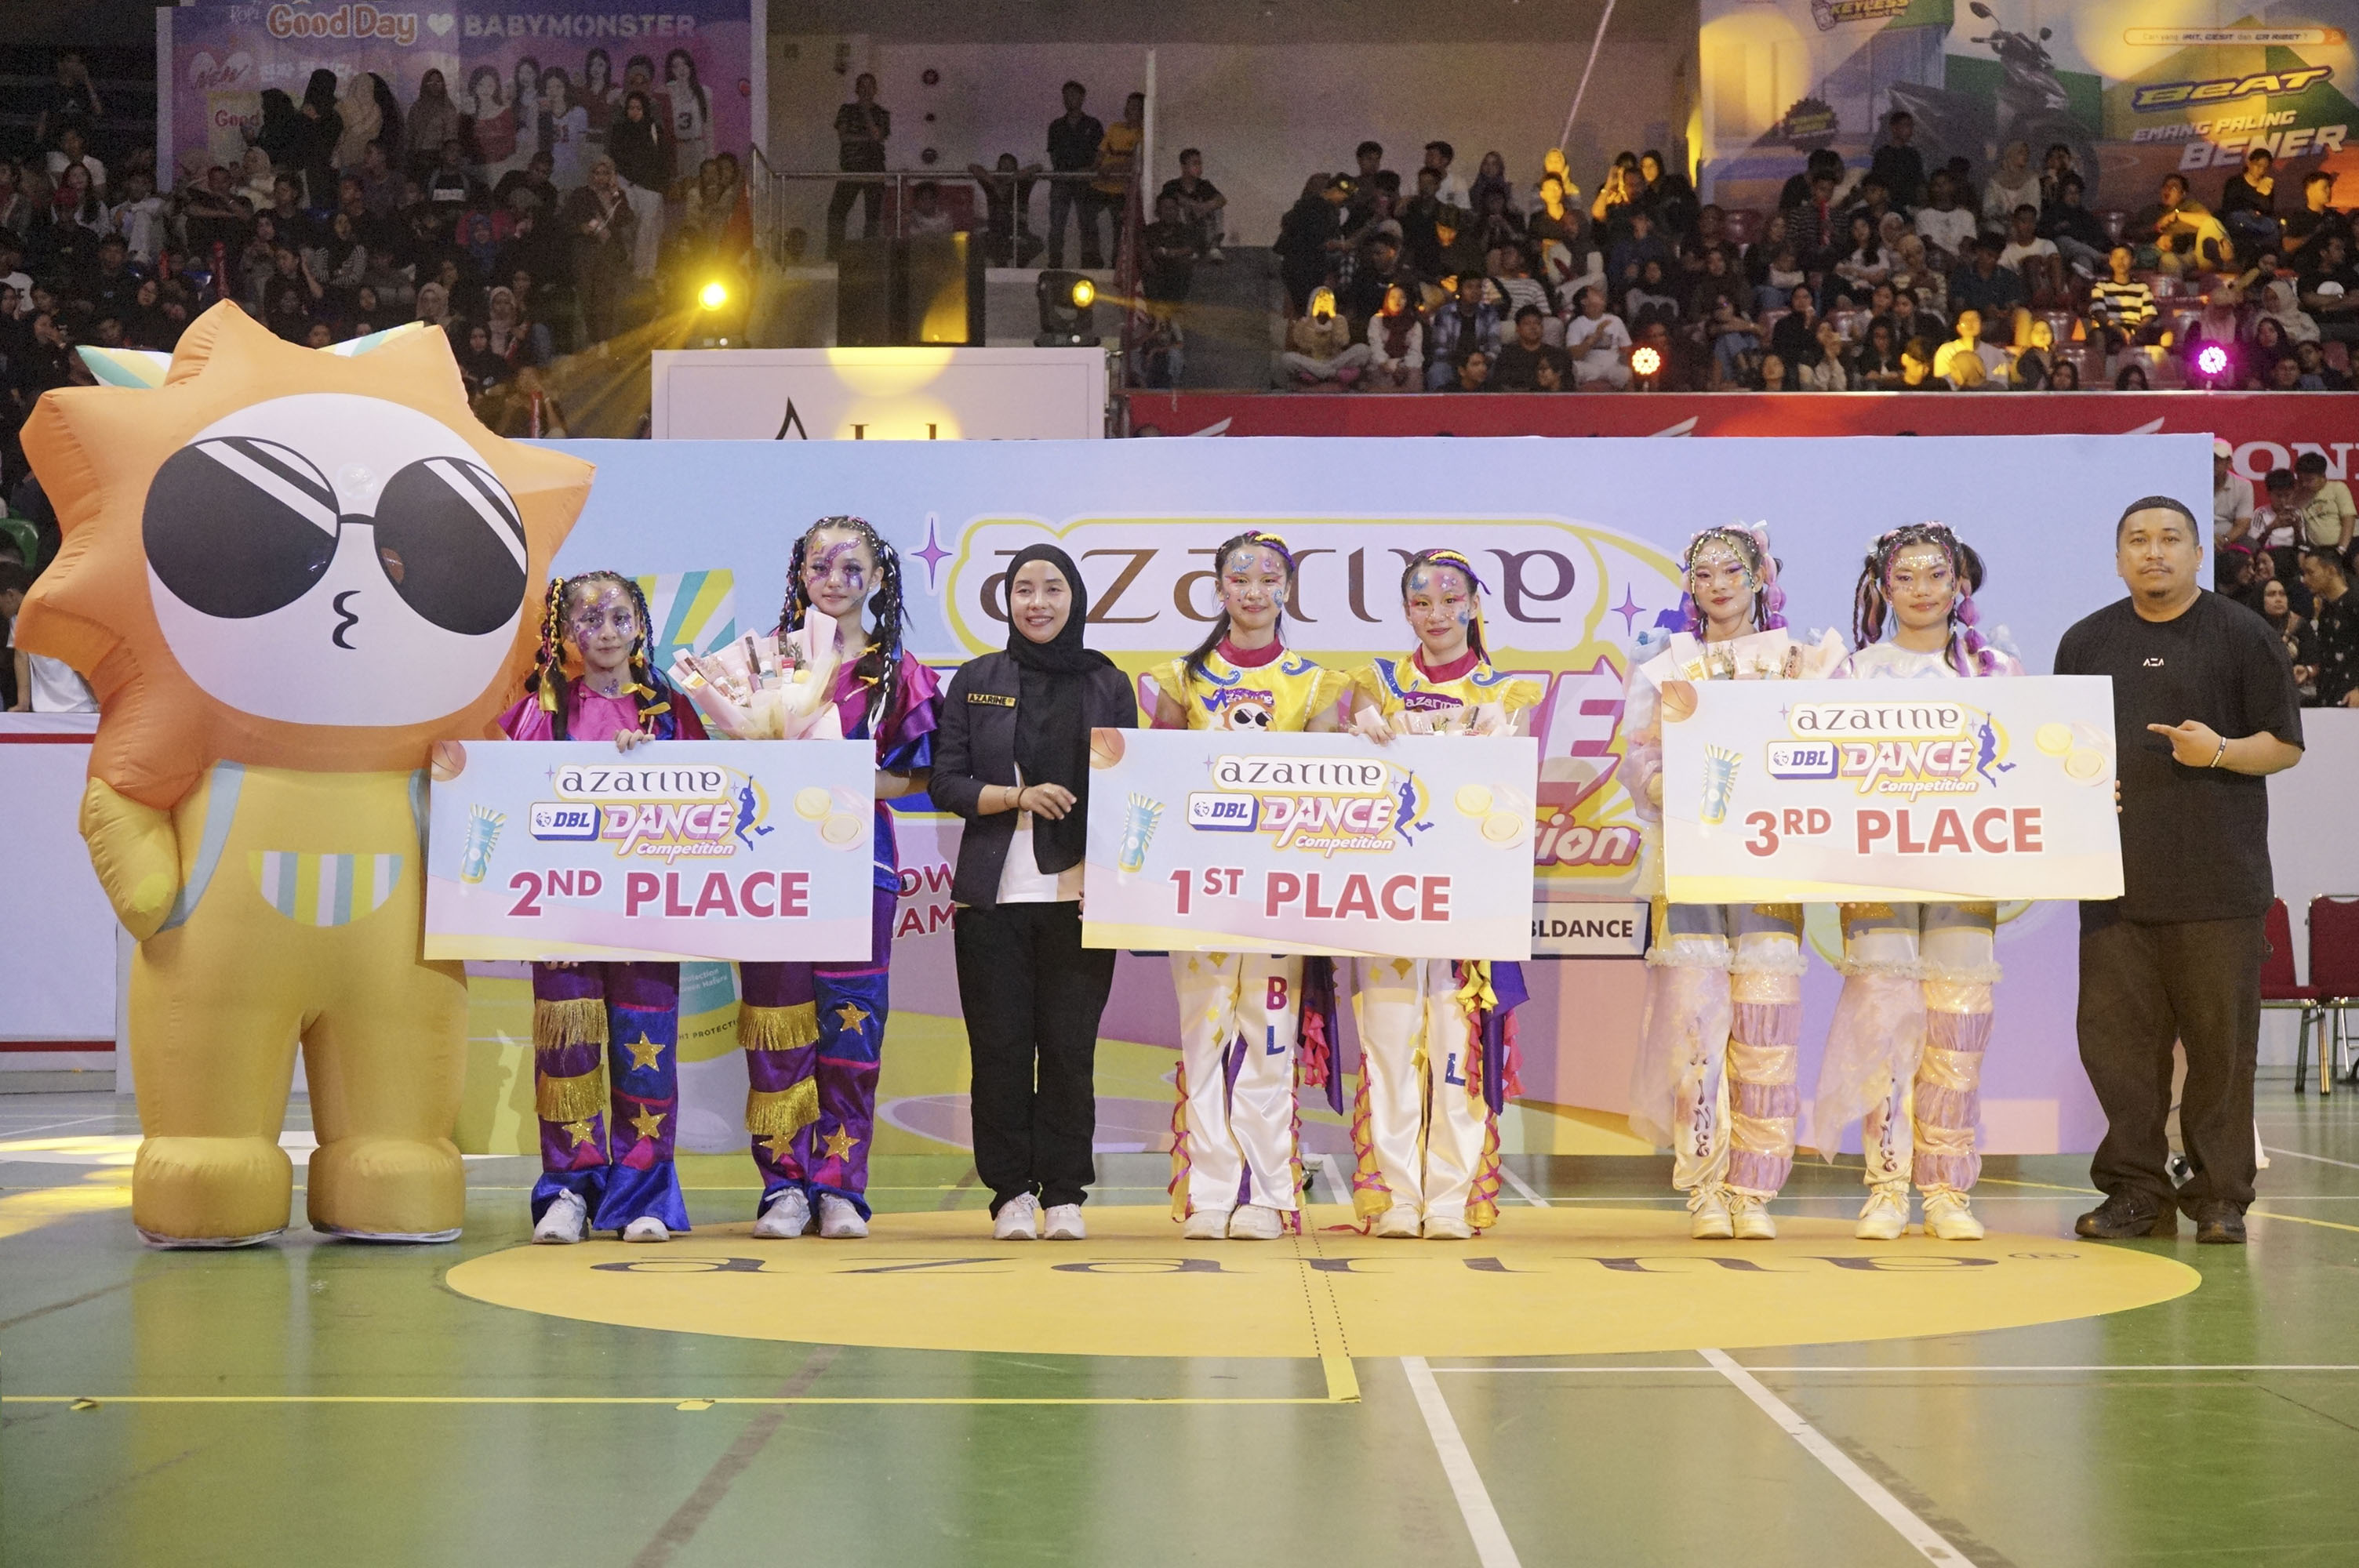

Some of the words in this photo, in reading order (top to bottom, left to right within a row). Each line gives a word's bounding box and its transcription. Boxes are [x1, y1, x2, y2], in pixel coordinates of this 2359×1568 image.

[267, 4, 351, 38] Good
[352, 4, 417, 45] Day
[464, 14, 696, 37] BABYMONSTER
[2132, 120, 2212, 142] EMANG
[2216, 110, 2297, 133] PALING
[2179, 124, 2349, 172] BENER
[969, 694, 1007, 706] AZARINE
[1797, 708, 1959, 730] azarine
[562, 771, 721, 793] azarine
[1220, 761, 1381, 786] azarine
[1791, 750, 1828, 766] DBL
[1841, 739, 1975, 793] DANCE
[1877, 778, 1979, 802] Competition
[553, 811, 591, 827] DBL
[602, 801, 735, 855] DANCE
[1211, 802, 1248, 818] DBL
[1260, 795, 1394, 848] DANCE
[1744, 808, 1832, 858] 3RD
[1856, 808, 2044, 855] PLACE
[636, 840, 736, 865] Competition
[1294, 835, 1395, 858] Competition
[507, 869, 602, 917] 2ND
[626, 871, 809, 917] PLACE
[1169, 866, 1245, 915] 1ST
[1265, 872, 1452, 921] PLACE
